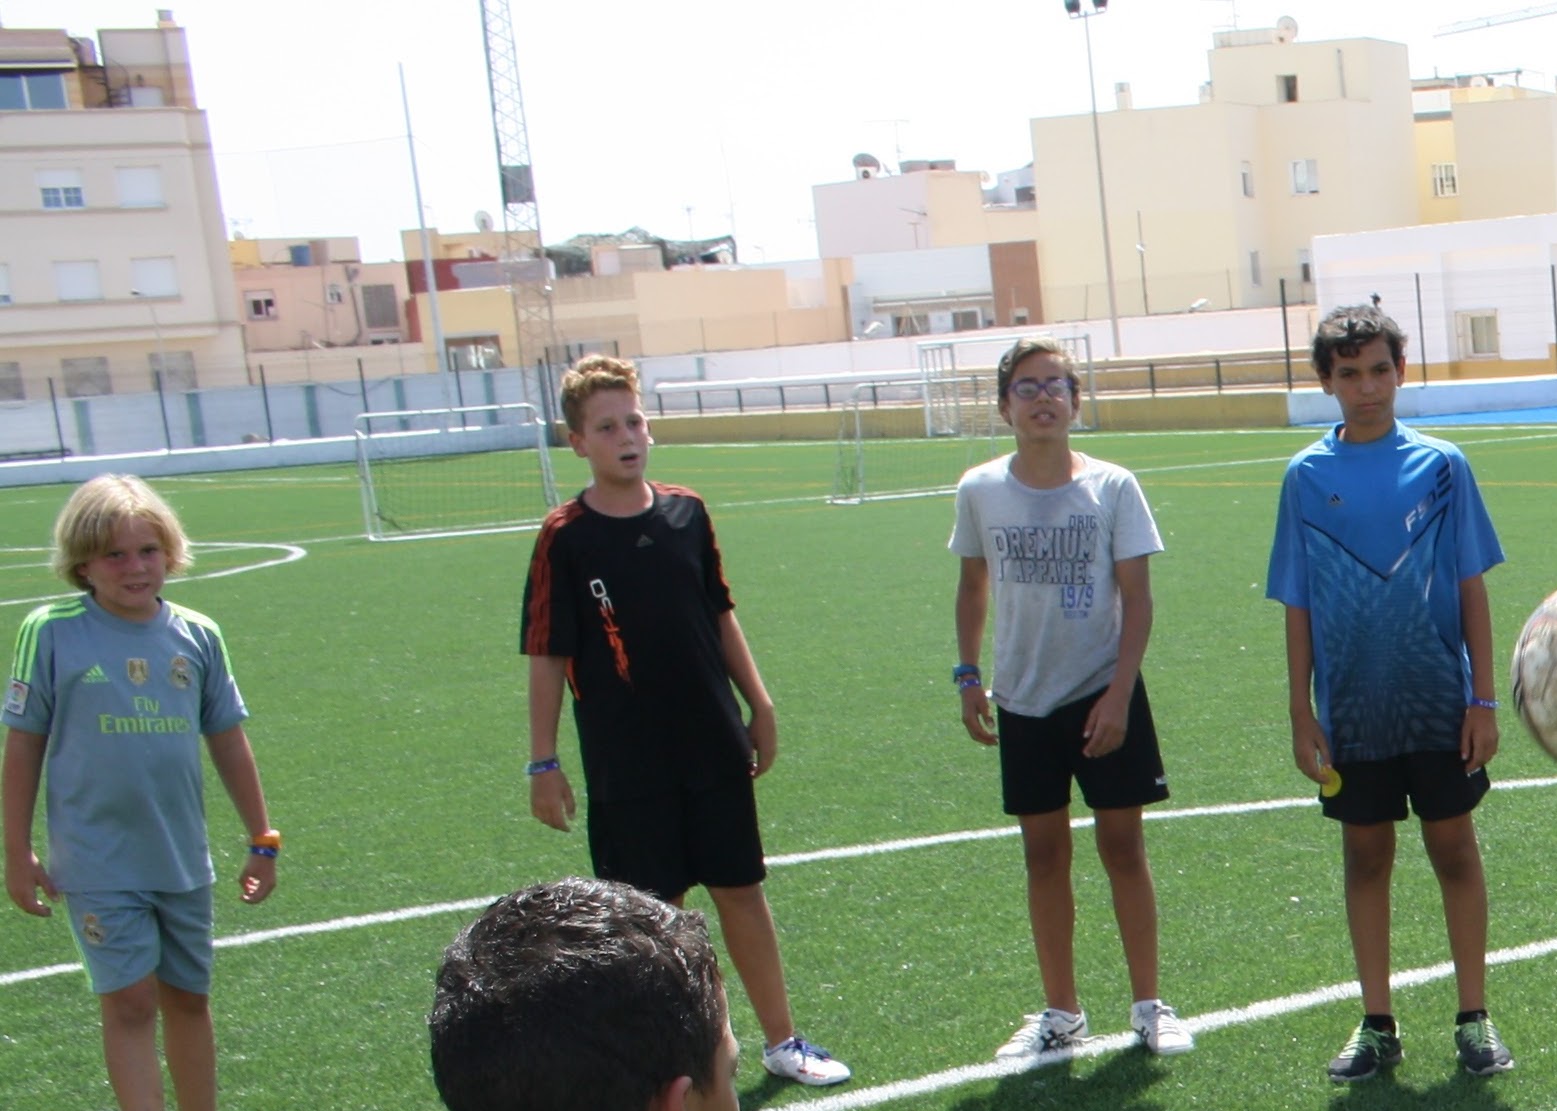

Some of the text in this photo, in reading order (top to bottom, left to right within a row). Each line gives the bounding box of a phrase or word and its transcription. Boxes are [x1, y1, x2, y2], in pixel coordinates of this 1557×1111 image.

[988, 526, 1098, 581] PREMIUM
[1016, 559, 1096, 585] APPAREL
[132, 696, 161, 714] Fly
[98, 713, 191, 734] Emirates
